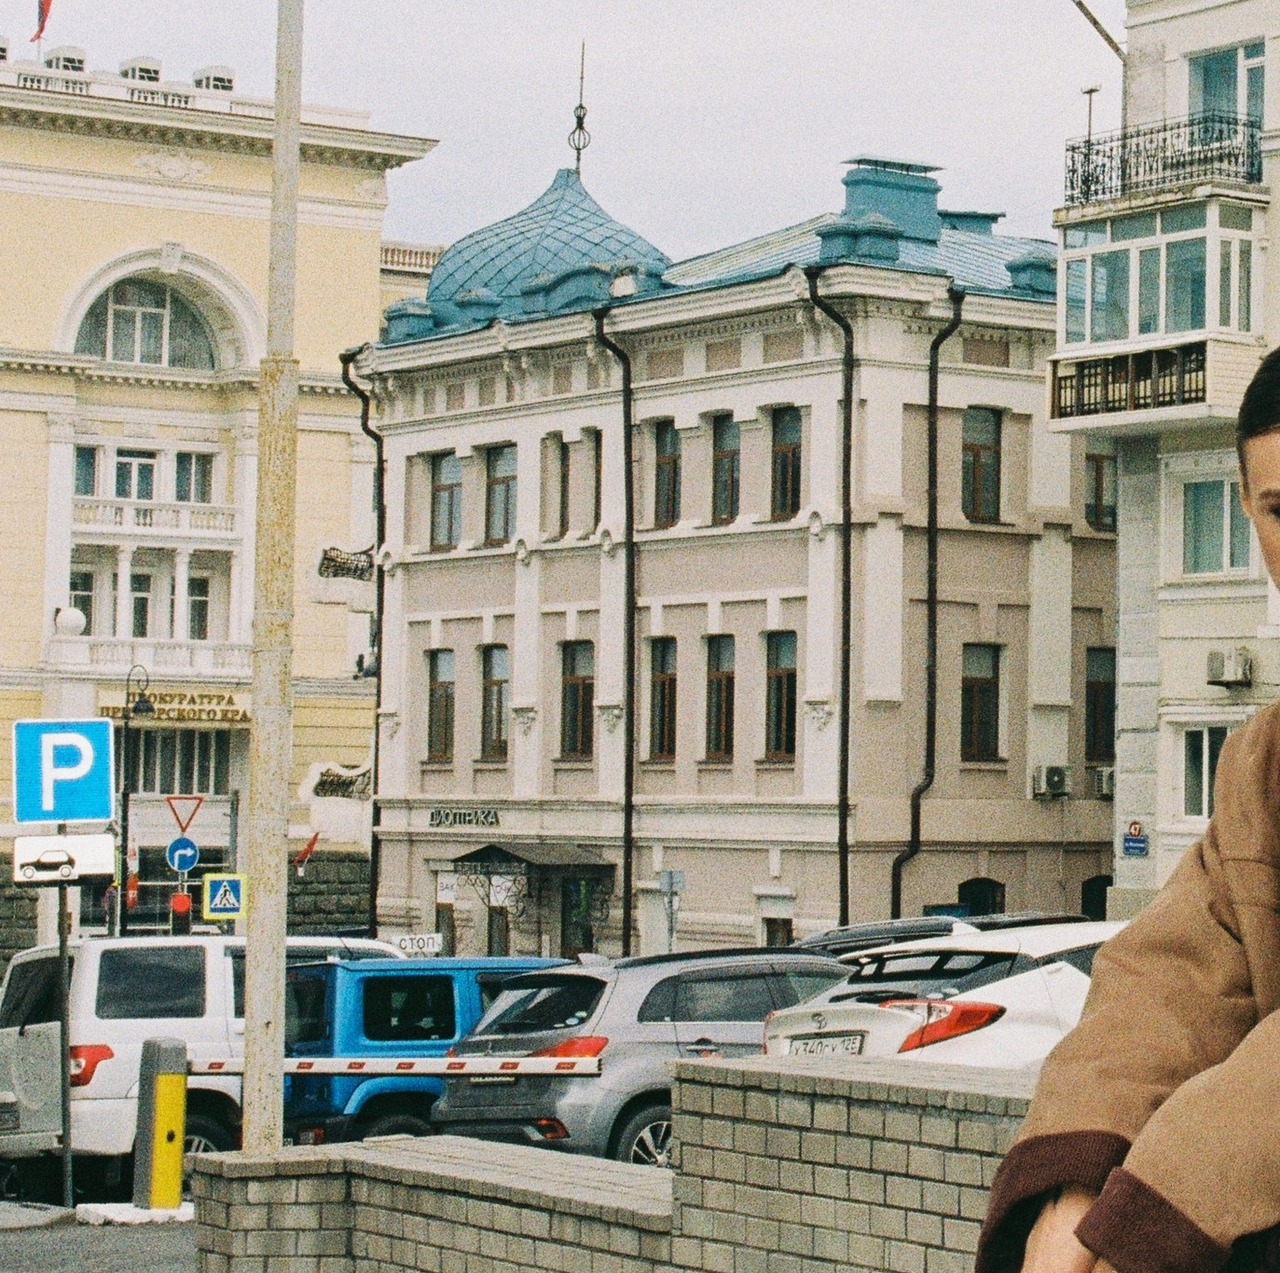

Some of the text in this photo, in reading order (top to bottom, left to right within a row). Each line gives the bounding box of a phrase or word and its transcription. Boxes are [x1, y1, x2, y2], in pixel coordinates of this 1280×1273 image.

[126, 692, 235, 705] ПОКУРАТУРА
[100, 707, 217, 720] ПРРСКОГО
[41, 733, 94, 812] P
[429, 809, 500, 827] ДИОПТРИКА
[399, 937, 435, 950] СТОП
